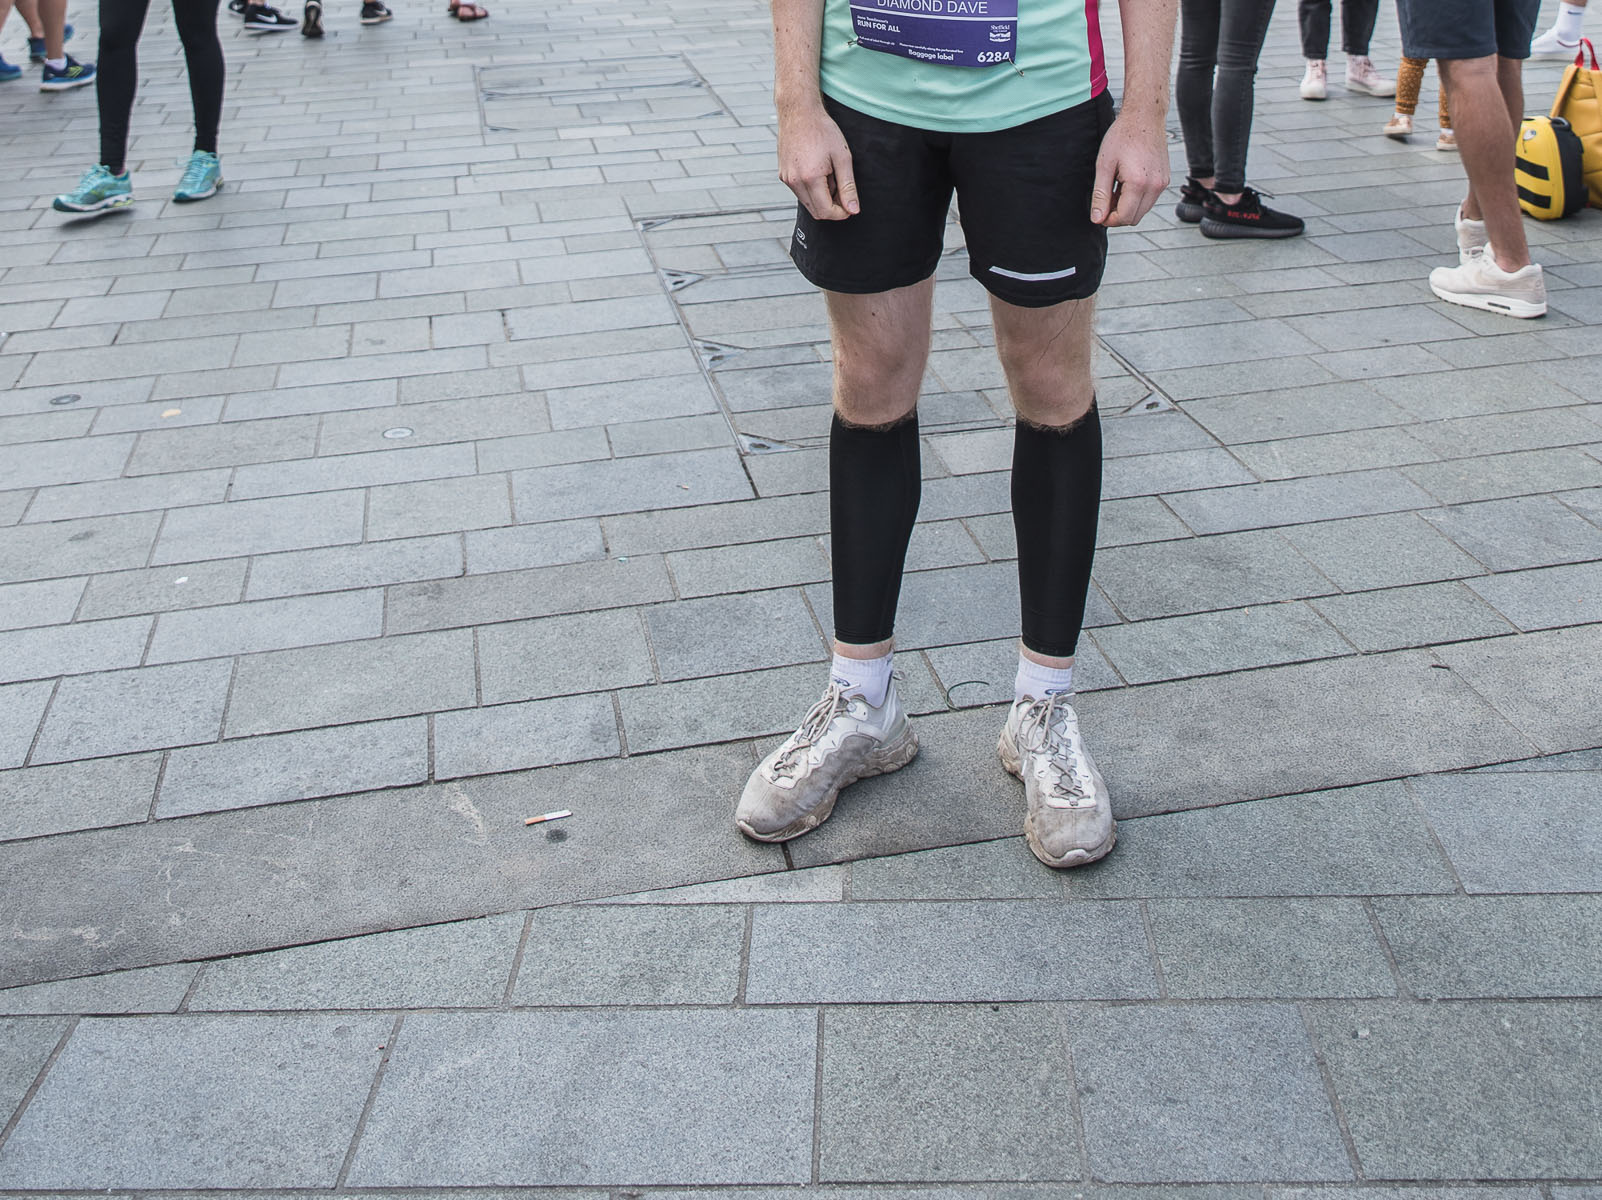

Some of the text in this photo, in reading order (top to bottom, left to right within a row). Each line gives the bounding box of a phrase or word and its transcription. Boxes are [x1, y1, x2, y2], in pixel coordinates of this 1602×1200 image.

[947, 0, 988, 14] DAVE
[857, 19, 901, 33] RUN FOR ALL
[908, 49, 954, 61] Baggage label
[977, 51, 1010, 63] 6284
